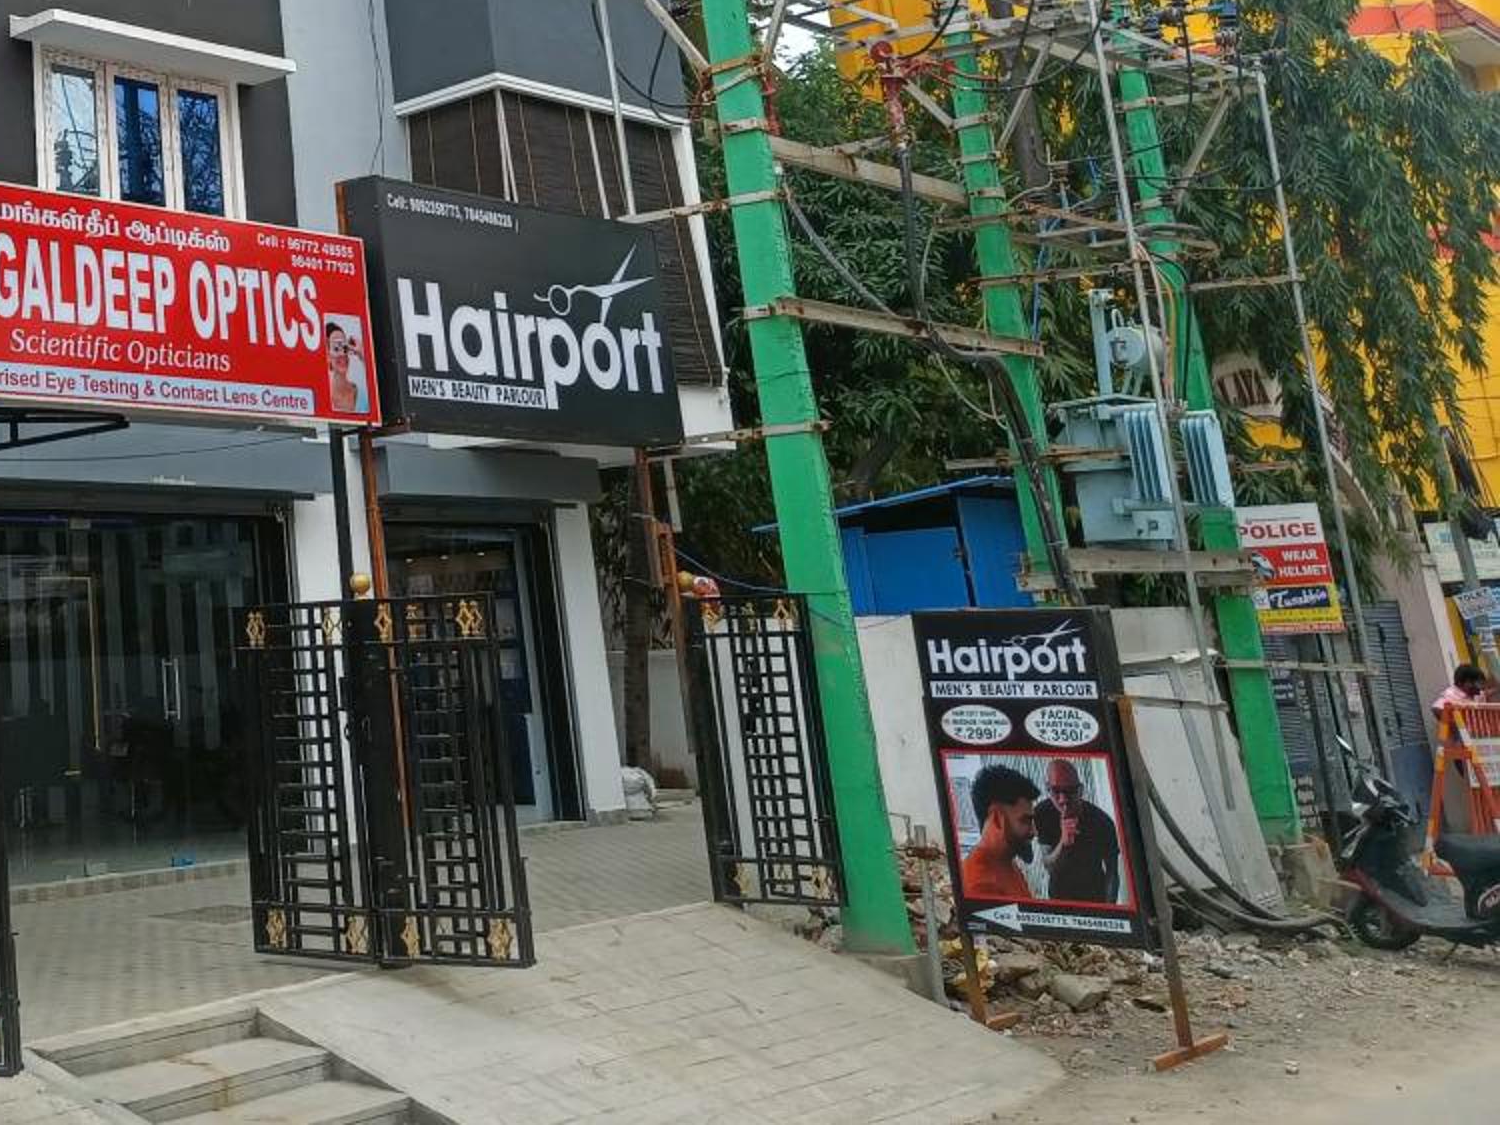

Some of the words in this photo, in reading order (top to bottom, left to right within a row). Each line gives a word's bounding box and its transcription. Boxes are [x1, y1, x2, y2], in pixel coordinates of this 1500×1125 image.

[189, 260, 322, 352] OPTICS
[10, 328, 120, 365] Scientific
[127, 339, 231, 373] Opticians
[397, 277, 664, 411] Hairport
[45, 372, 76, 394] Eye
[82, 375, 139, 400] Testing
[145, 382, 155, 396] &
[160, 381, 218, 403] Contact
[223, 388, 258, 405] Lens
[261, 390, 309, 410] Centre
[411, 378, 446, 396] MEN'S
[451, 382, 490, 401] BEAUTY
[496, 386, 543, 406] PARLOUR
[1280, 564, 1328, 578] HELMET
[1282, 549, 1318, 562] WEAR
[927, 638, 1087, 680] Hairport
[934, 683, 973, 696] MEN'S
[979, 683, 1025, 696] BEAUTY
[1033, 683, 1093, 697] PARLOUR
[1040, 709, 1083, 720] FACIAL
